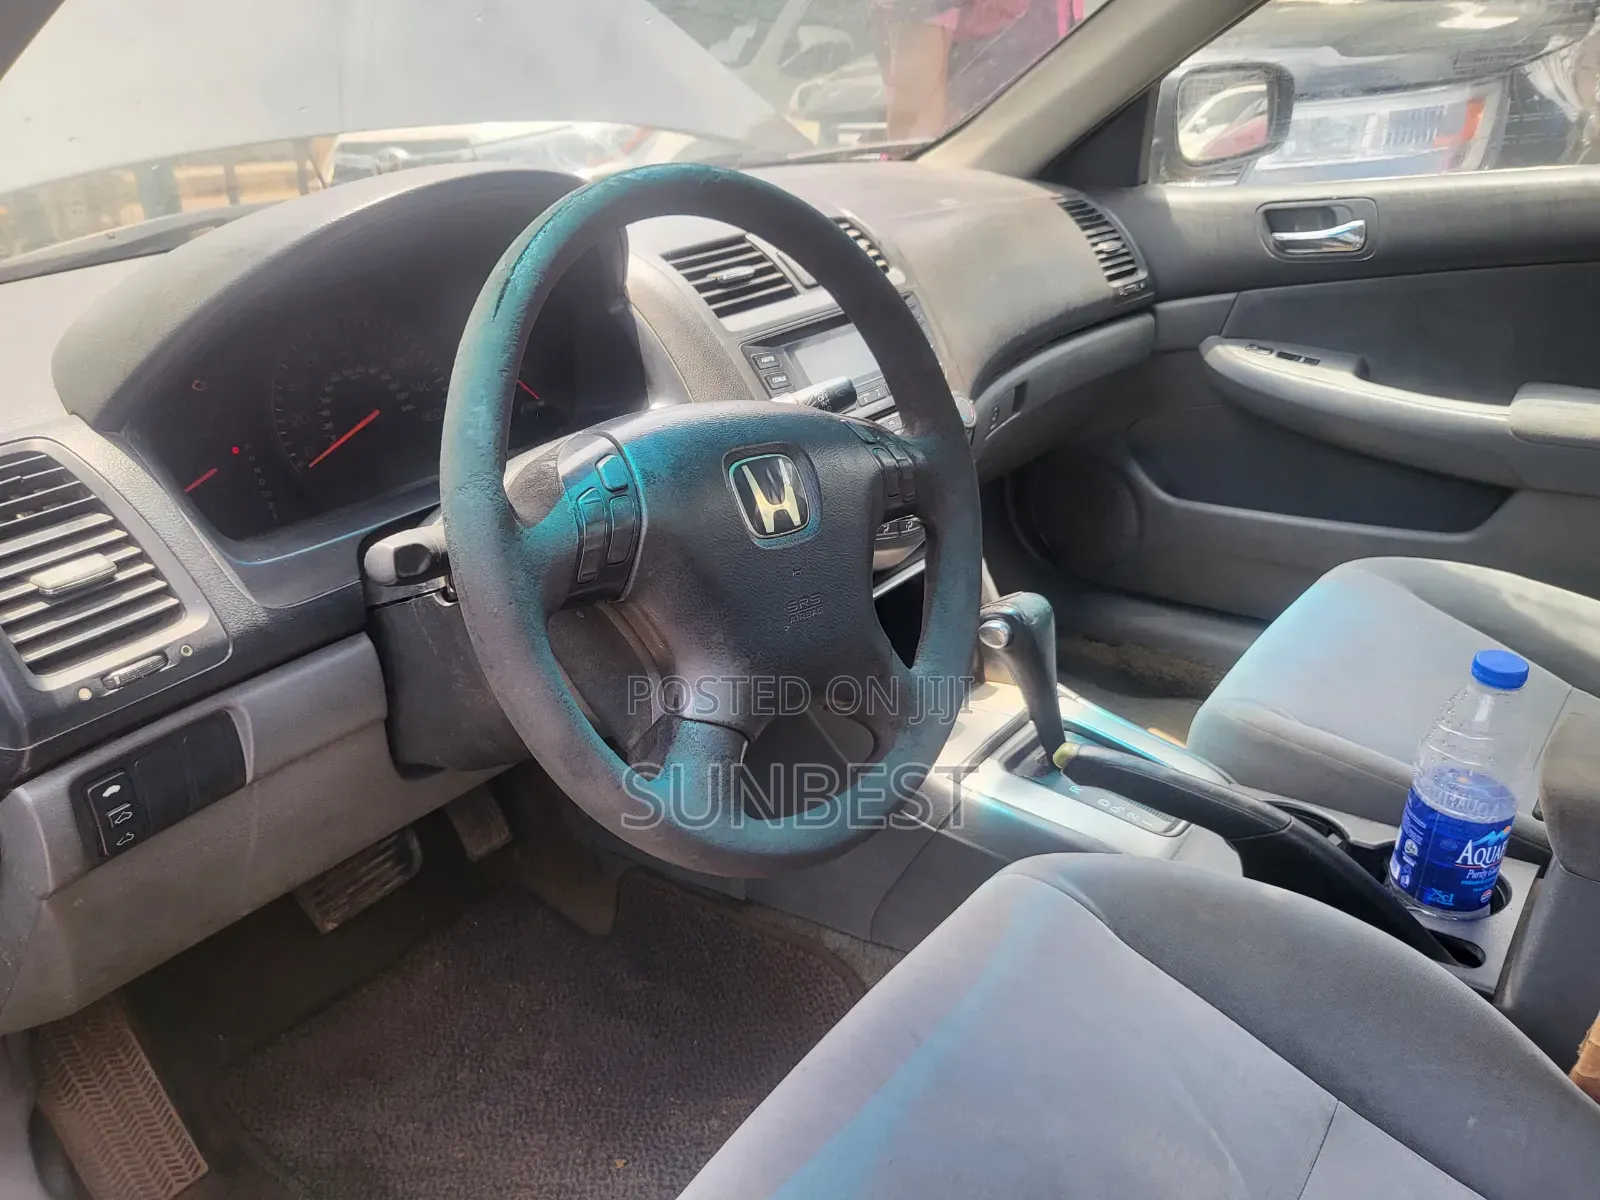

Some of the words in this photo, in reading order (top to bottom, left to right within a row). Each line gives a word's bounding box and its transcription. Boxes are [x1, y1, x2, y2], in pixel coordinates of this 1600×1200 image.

[787, 593, 821, 613] SRS
[790, 606, 824, 624] AIRBAG
[1068, 785, 1083, 795] R
[1096, 798, 1111, 808] D
